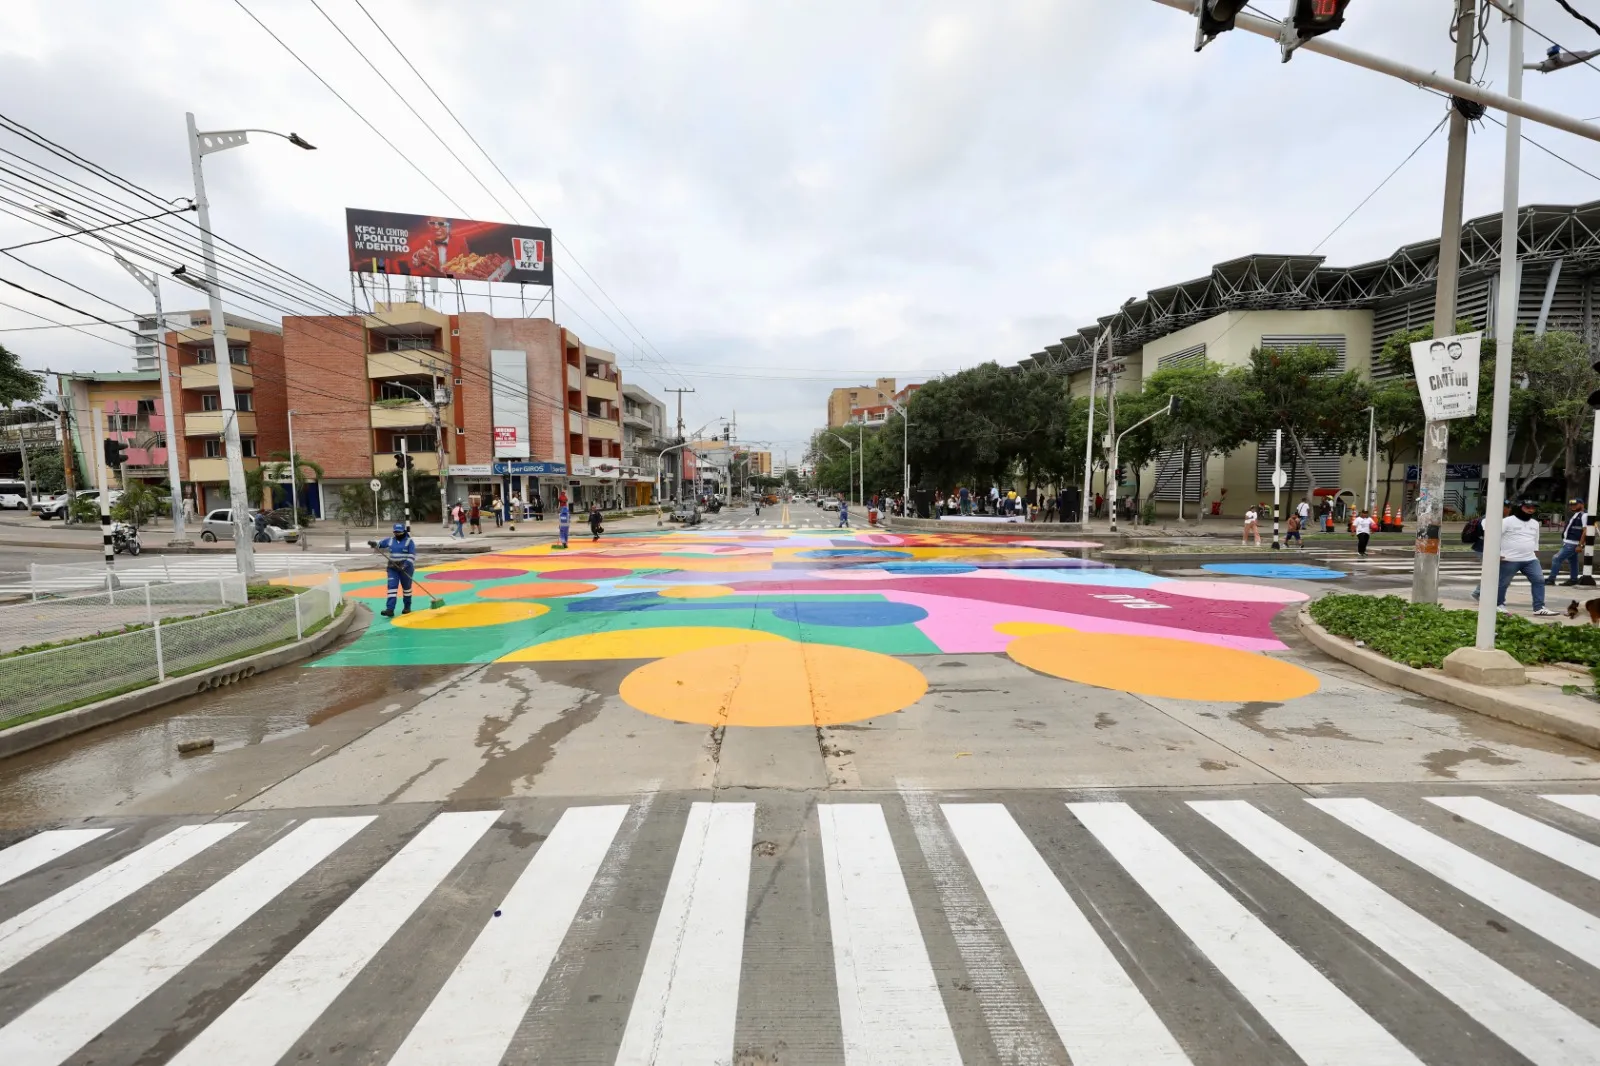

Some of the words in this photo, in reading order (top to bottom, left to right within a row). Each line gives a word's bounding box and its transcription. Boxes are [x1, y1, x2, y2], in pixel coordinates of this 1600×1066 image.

[355, 225, 375, 234] KFC
[386, 228, 408, 237] CENTRO
[363, 234, 407, 245] POLLITO
[366, 242, 410, 252] DENTRO
[520, 261, 540, 269] KFC
